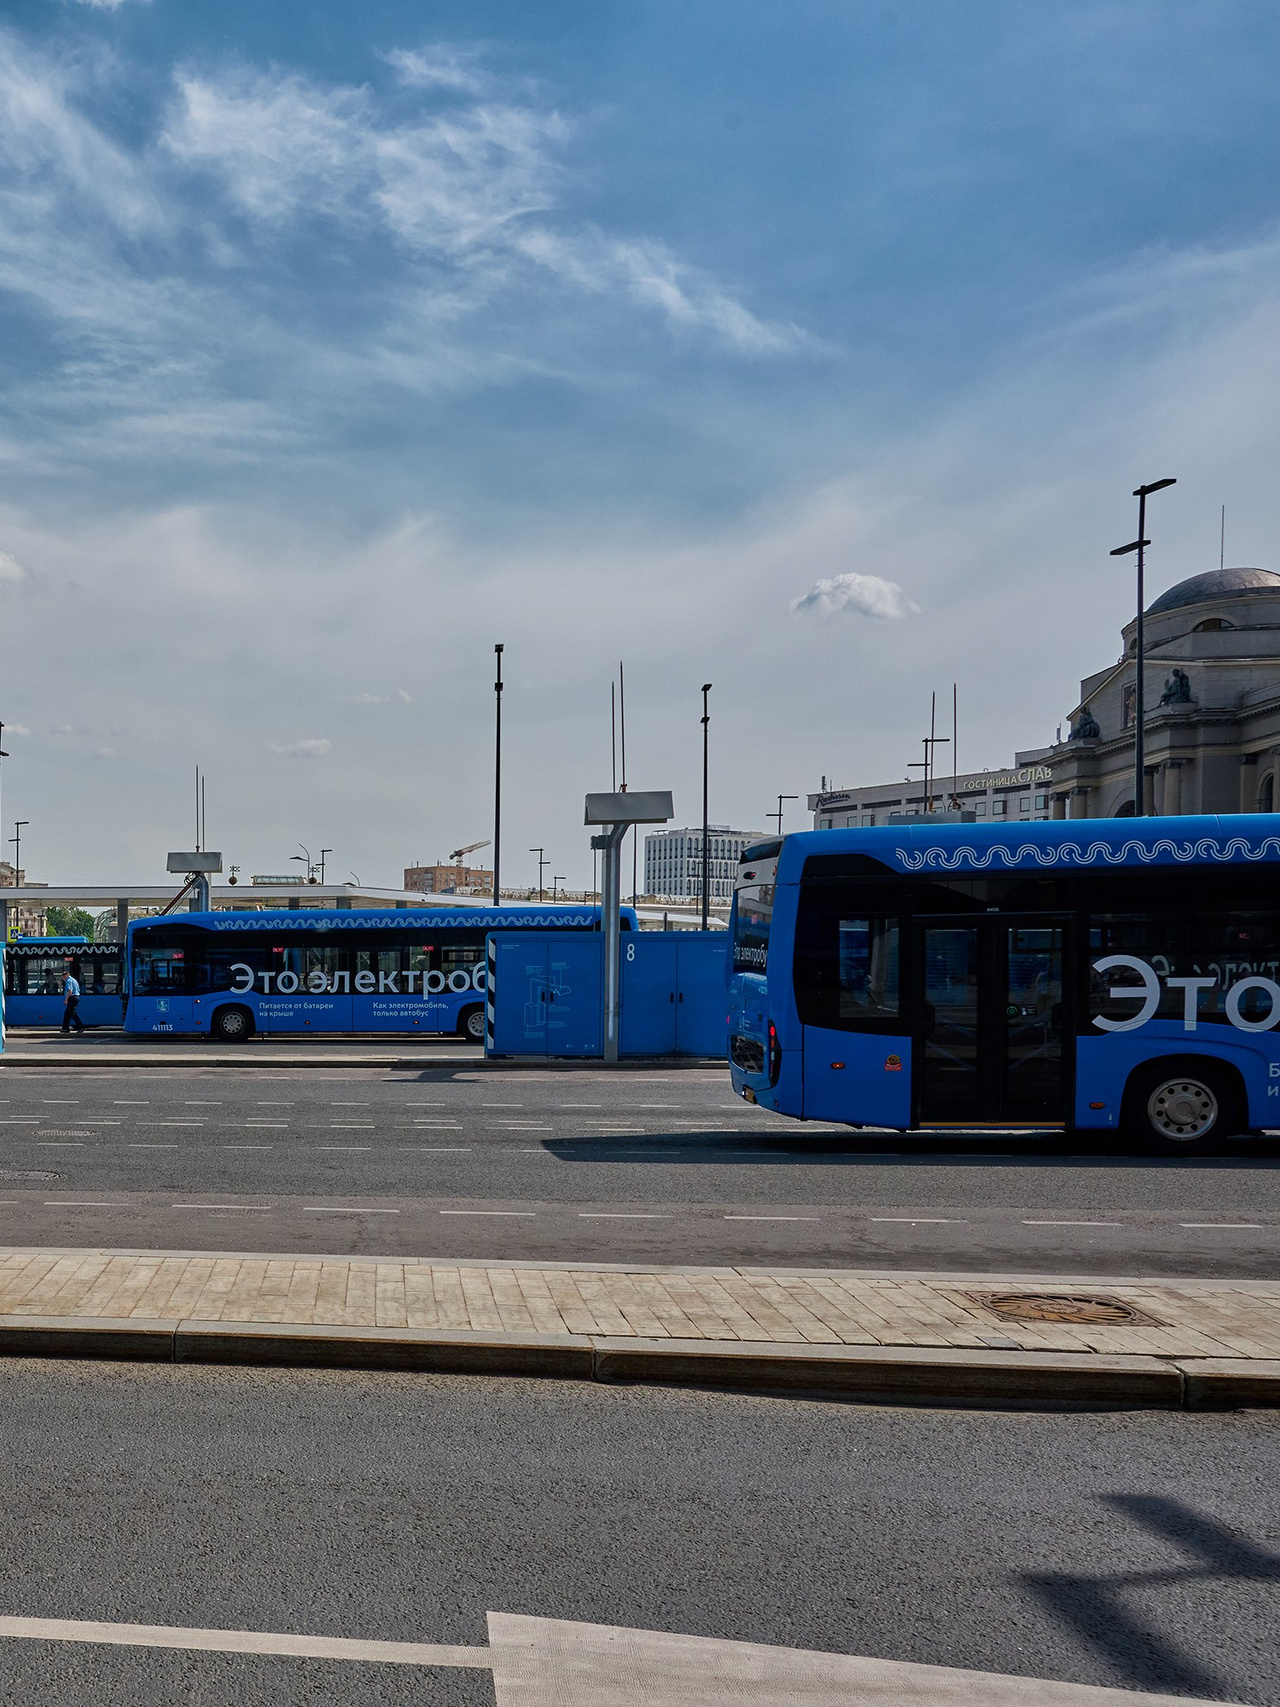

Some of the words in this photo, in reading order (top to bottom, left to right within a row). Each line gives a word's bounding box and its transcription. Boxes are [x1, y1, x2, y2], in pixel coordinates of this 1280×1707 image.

[963, 775, 1017, 790] ГОСТИНИЦА
[626, 943, 635, 961] 8
[229, 963, 300, 994] Это
[1091, 954, 1280, 1033] Это
[259, 1002, 293, 1010] Питается
[303, 1001, 334, 1010] батареи
[388, 1001, 449, 1010] электромобиль,
[399, 1010, 429, 1018] автобус
